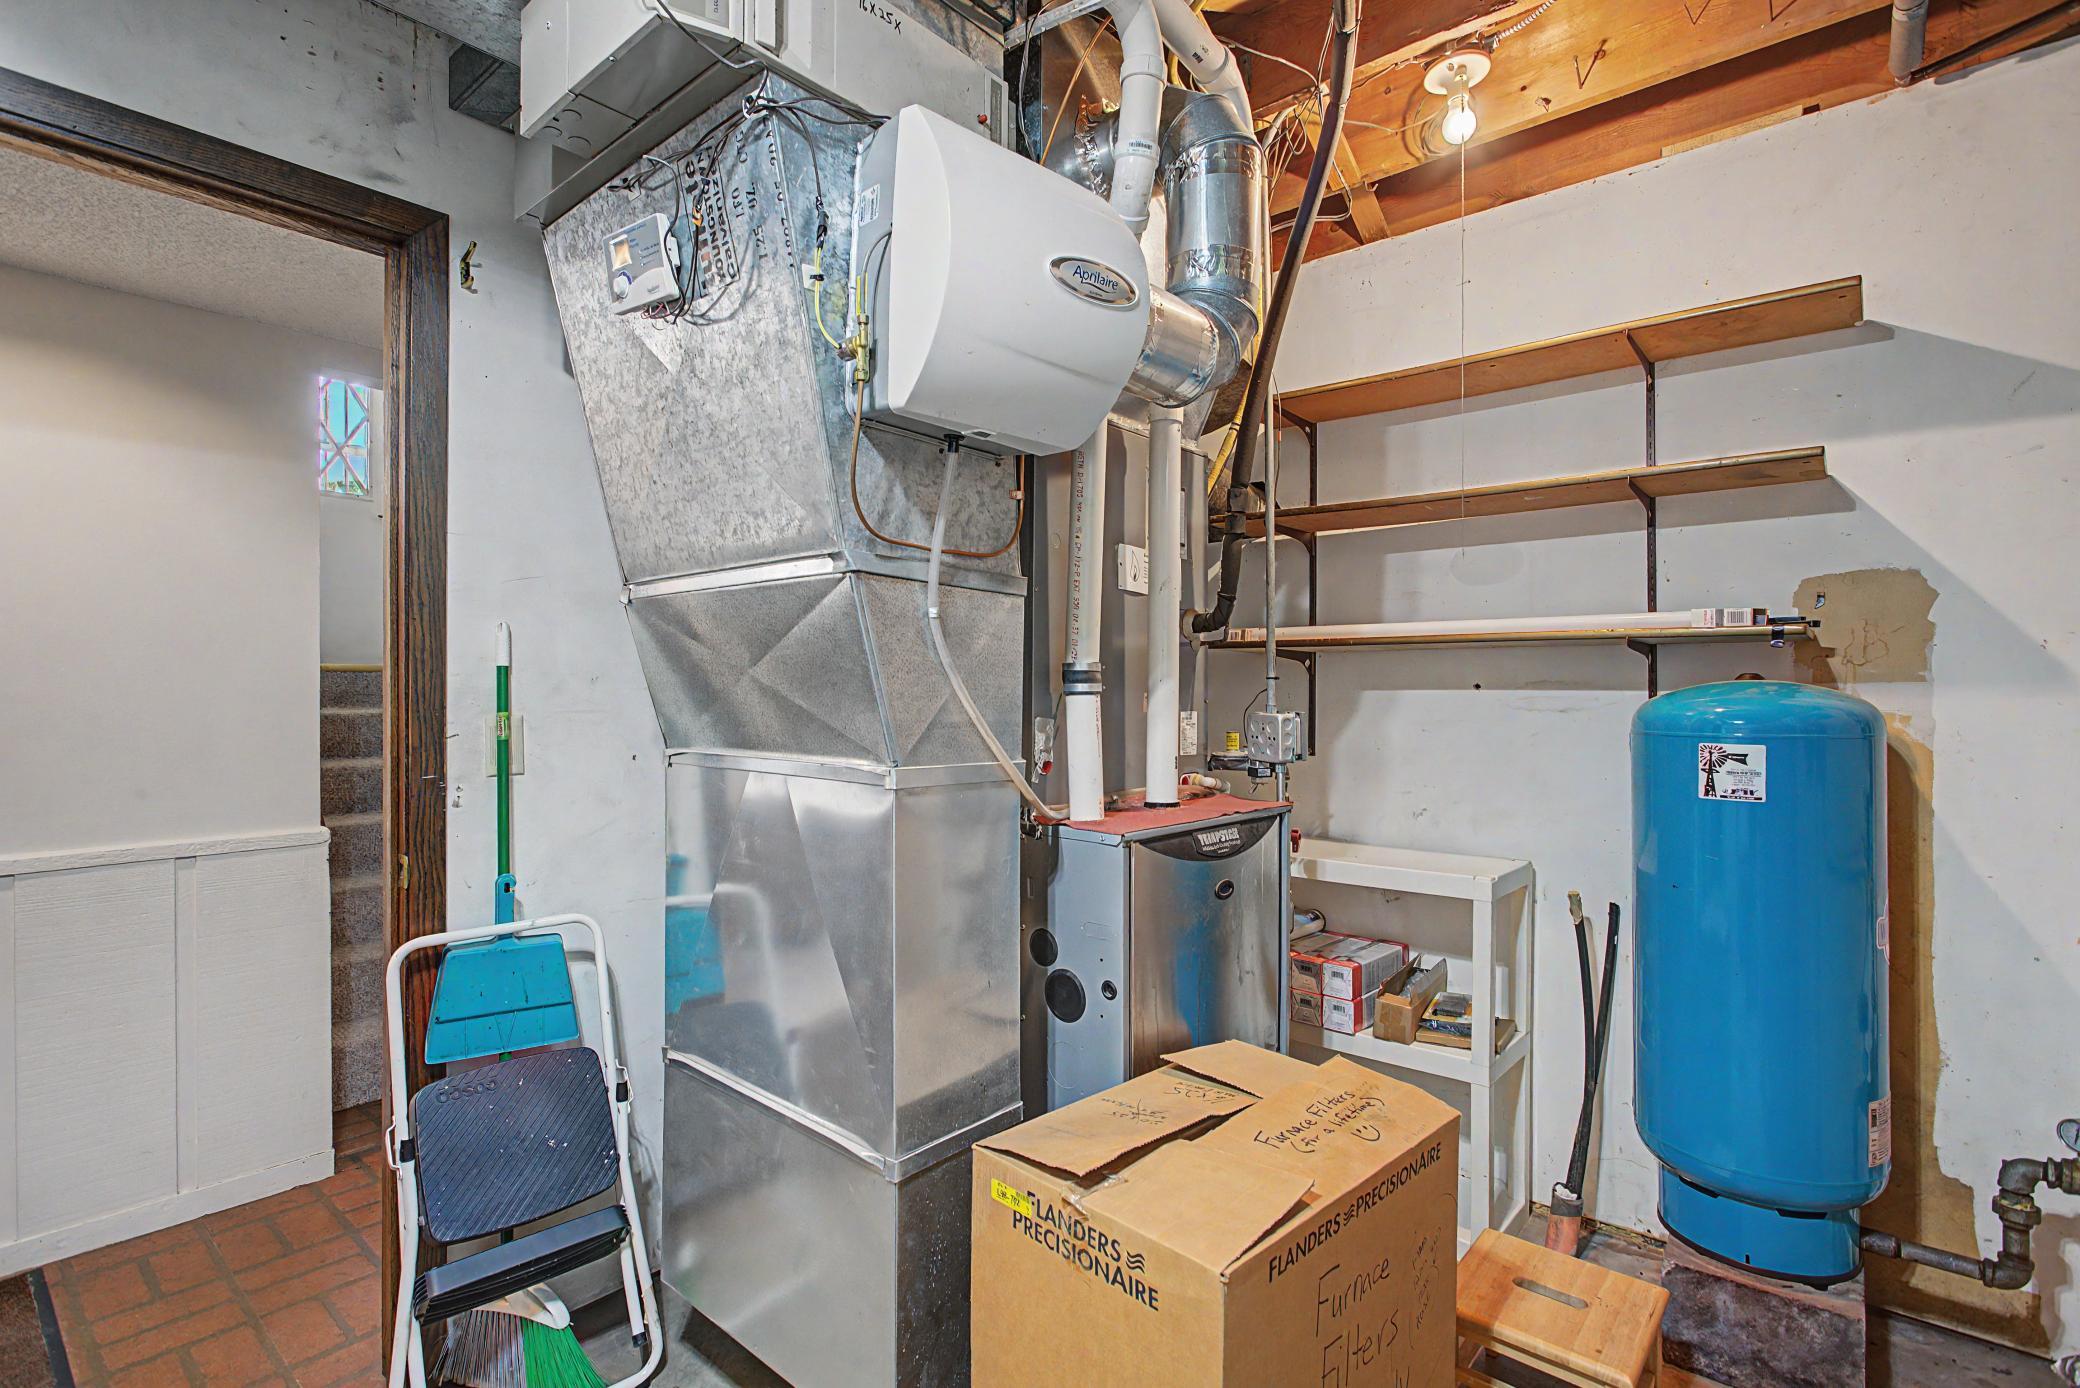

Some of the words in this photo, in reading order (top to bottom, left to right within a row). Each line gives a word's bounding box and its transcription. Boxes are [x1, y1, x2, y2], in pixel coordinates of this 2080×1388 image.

[1073, 264, 1119, 291] Aprilaire
[1254, 1119, 1318, 1150] Furnace
[1305, 1090, 1356, 1118] Filters
[1268, 1213, 1342, 1283] FLANDERS
[1355, 1142, 1442, 1219] PRECISIONAIRE
[1012, 1209, 1160, 1312] PRECISIONAIRE
[1315, 1258, 1392, 1338] Furnace
[1321, 1308, 1400, 1388] Filters
